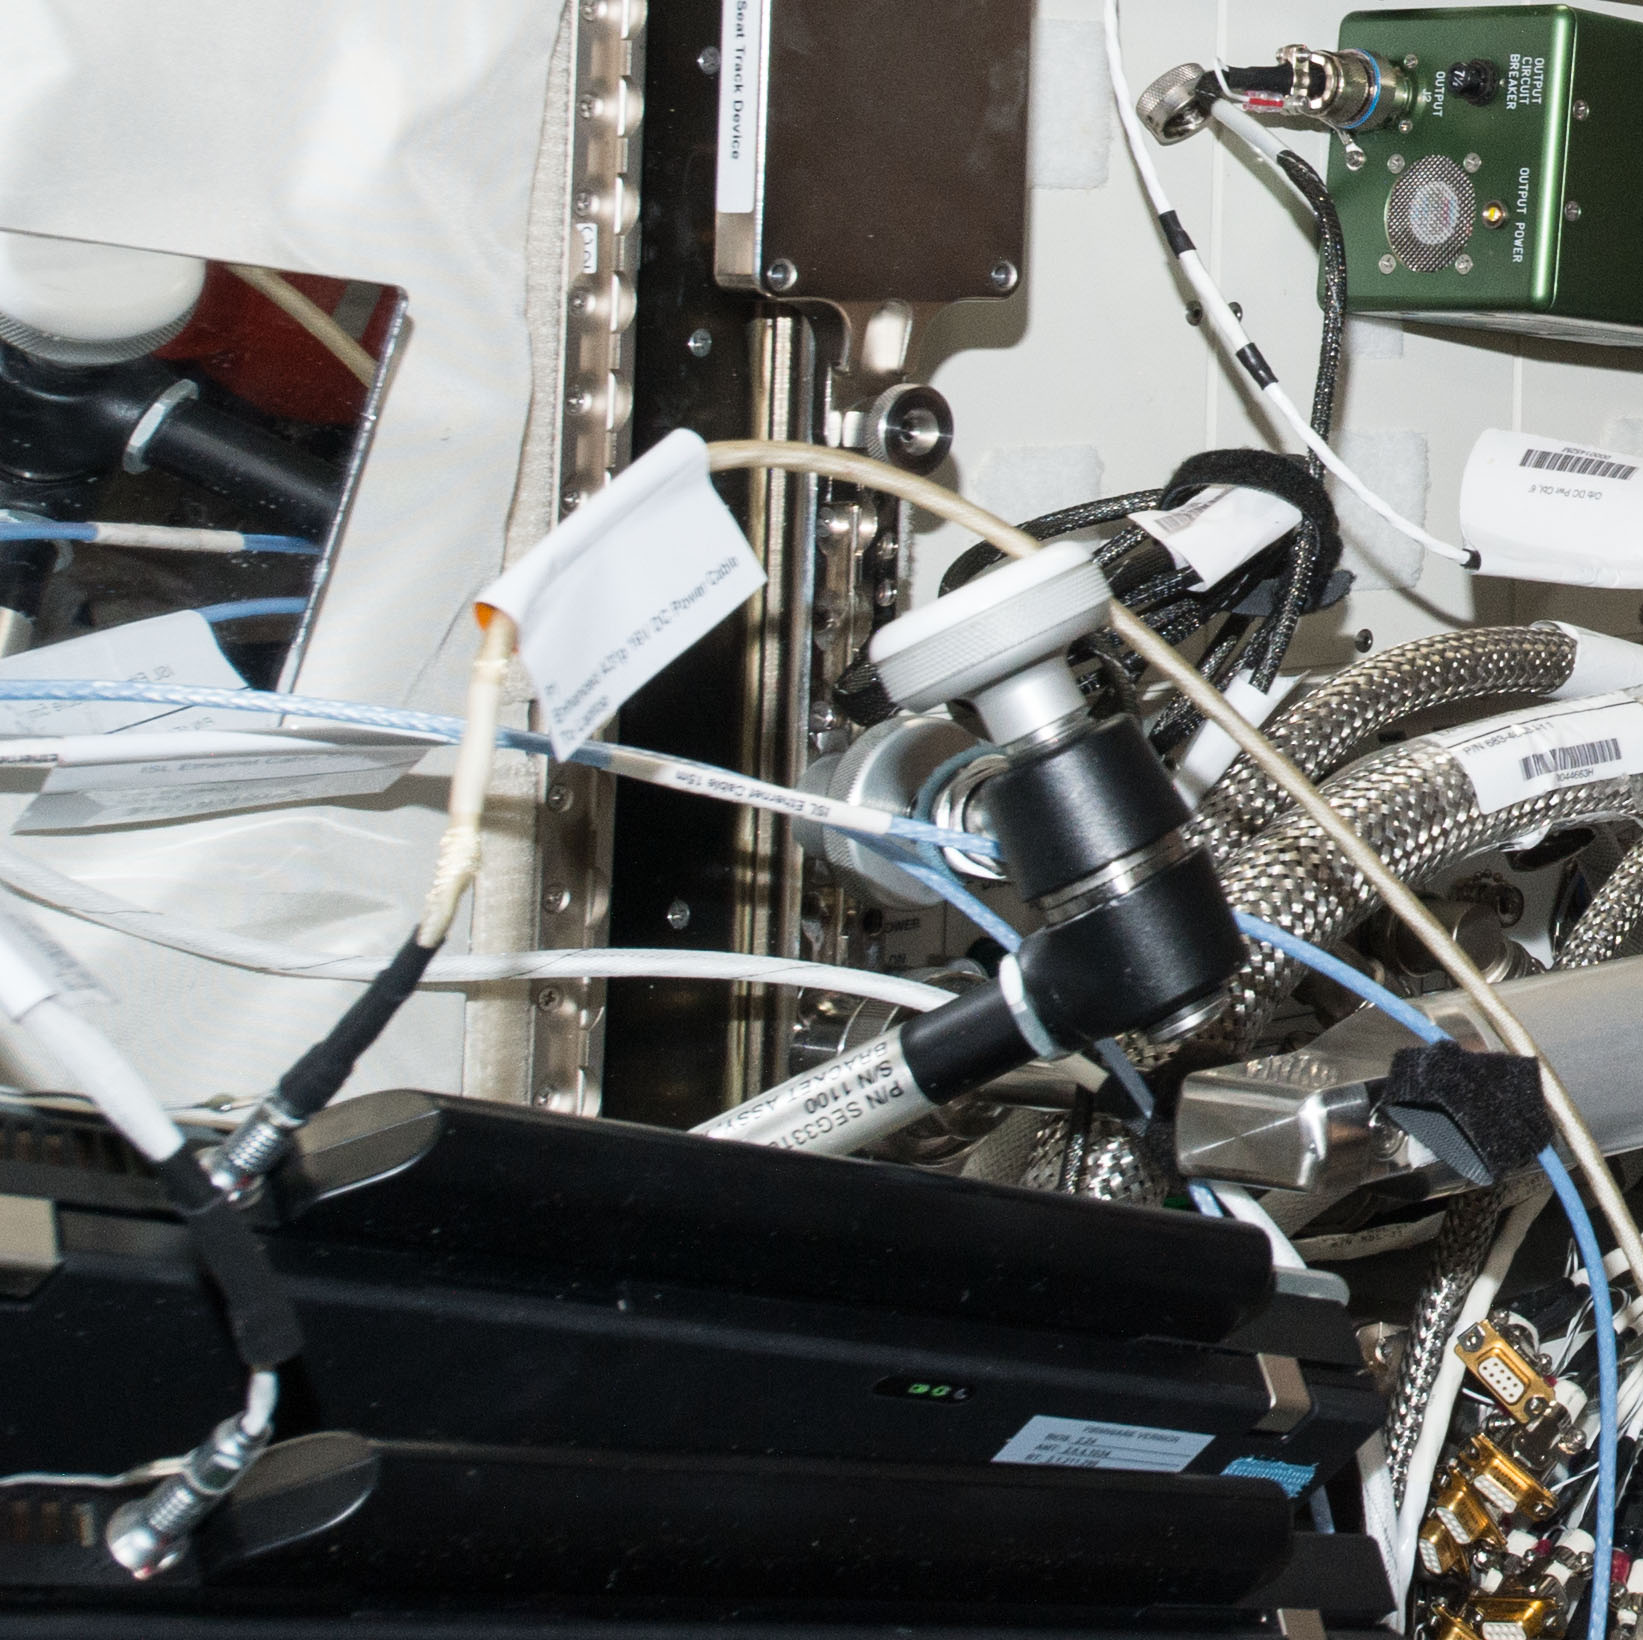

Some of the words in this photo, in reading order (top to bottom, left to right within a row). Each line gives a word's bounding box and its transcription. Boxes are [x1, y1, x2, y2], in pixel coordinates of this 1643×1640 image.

[735, 0, 748, 39] Seat
[733, 45, 747, 93] Track
[1506, 53, 1521, 111] BREAKER
[1519, 56, 1533, 105] CIRCUIT
[1531, 57, 1545, 105] OUTPUT
[1432, 70, 1446, 118] OUTPUT
[731, 100, 744, 160] Device
[1516, 167, 1530, 215] OUTPUT
[1512, 222, 1526, 263] POWER
[707, 777, 746, 797] Cable
[793, 1041, 888, 1098] BRACKET
[857, 1060, 892, 1087] S/N
[804, 1081, 852, 1114] 1100
[867, 1082, 905, 1109] P/N
